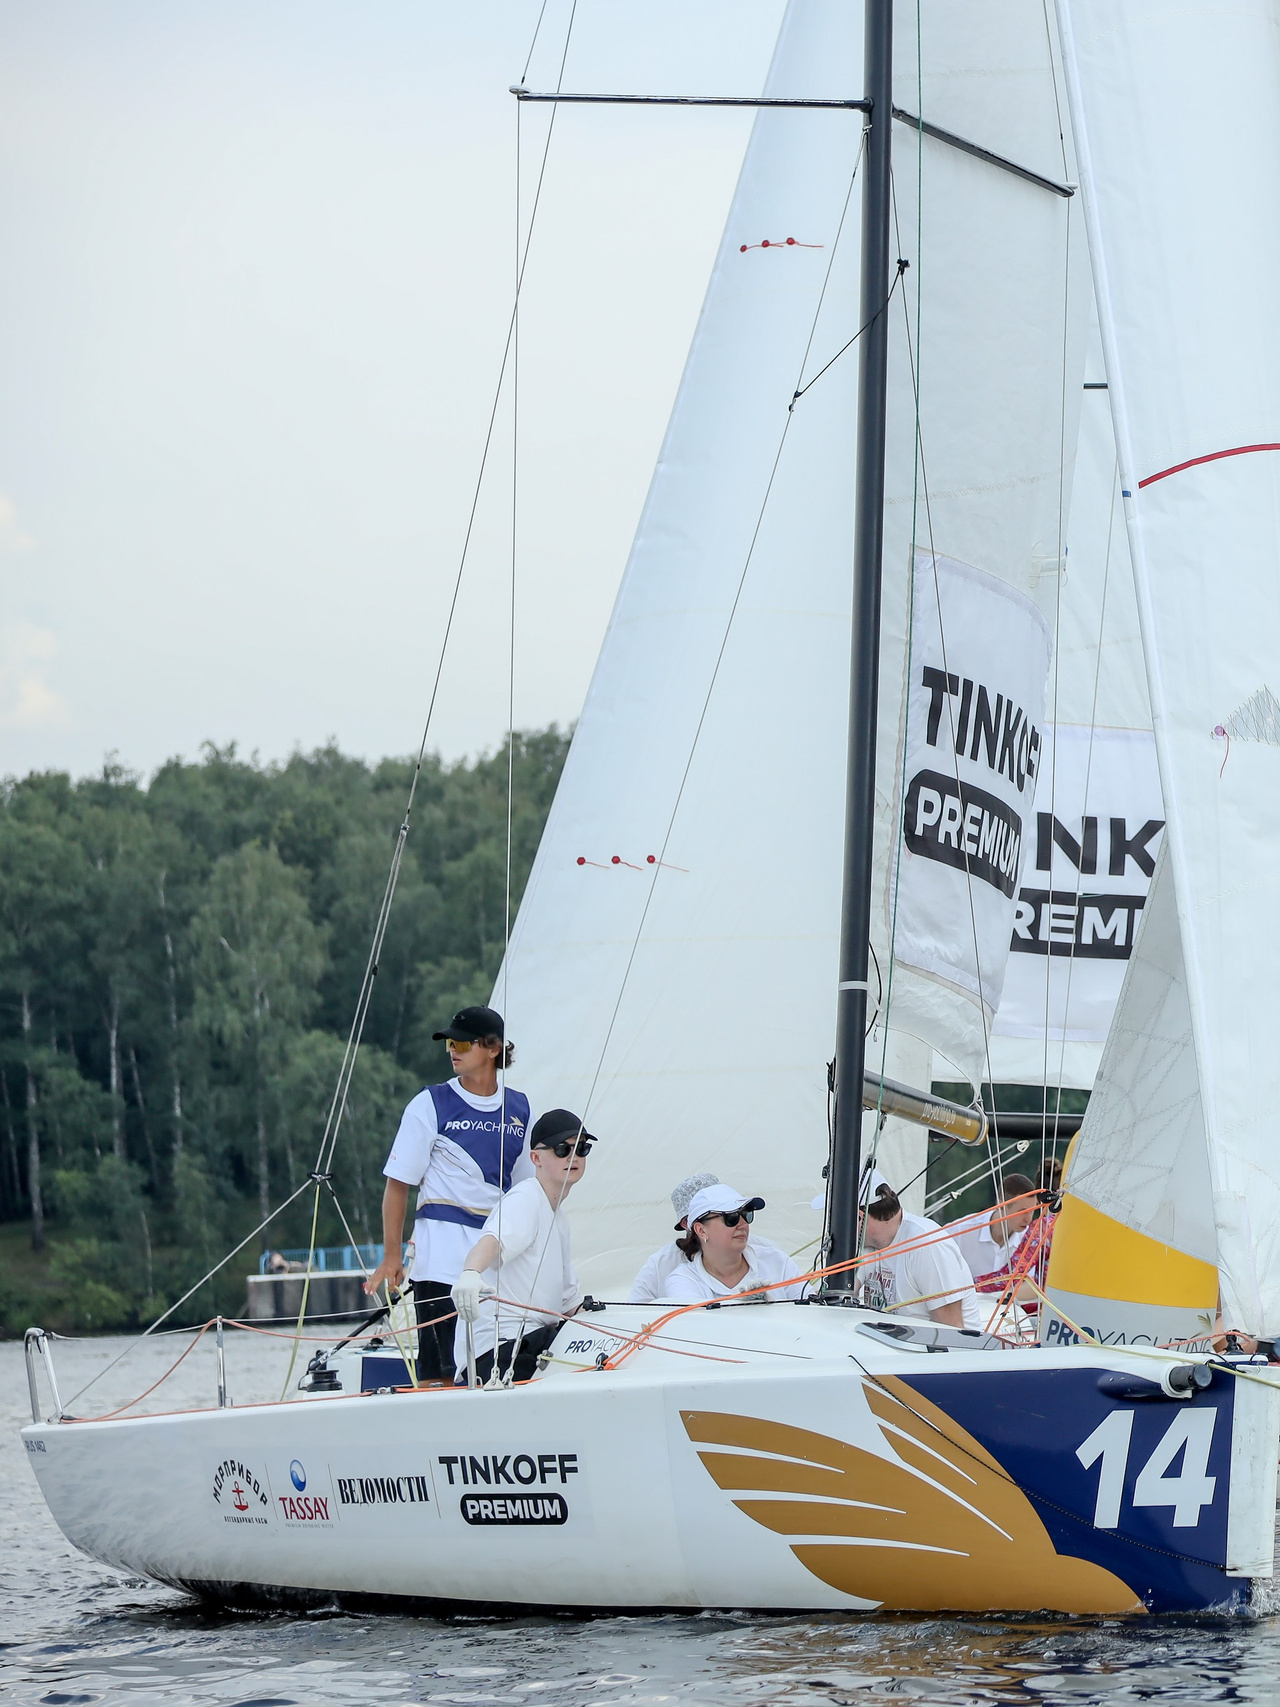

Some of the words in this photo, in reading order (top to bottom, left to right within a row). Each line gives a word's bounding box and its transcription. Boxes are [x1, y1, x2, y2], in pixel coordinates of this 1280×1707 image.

[922, 665, 1042, 793] TINKOF
[914, 785, 1020, 882] PREMIUM
[444, 1119, 525, 1138] PROYACHTING
[213, 1459, 268, 1505] МОРПРИБОР
[438, 1454, 579, 1485] TINKOFF
[1075, 1407, 1217, 1529] 14
[337, 1476, 430, 1508] ВЕДОМОСТИ
[279, 1497, 330, 1520] TASSAY
[467, 1498, 562, 1520] PREMIUM
